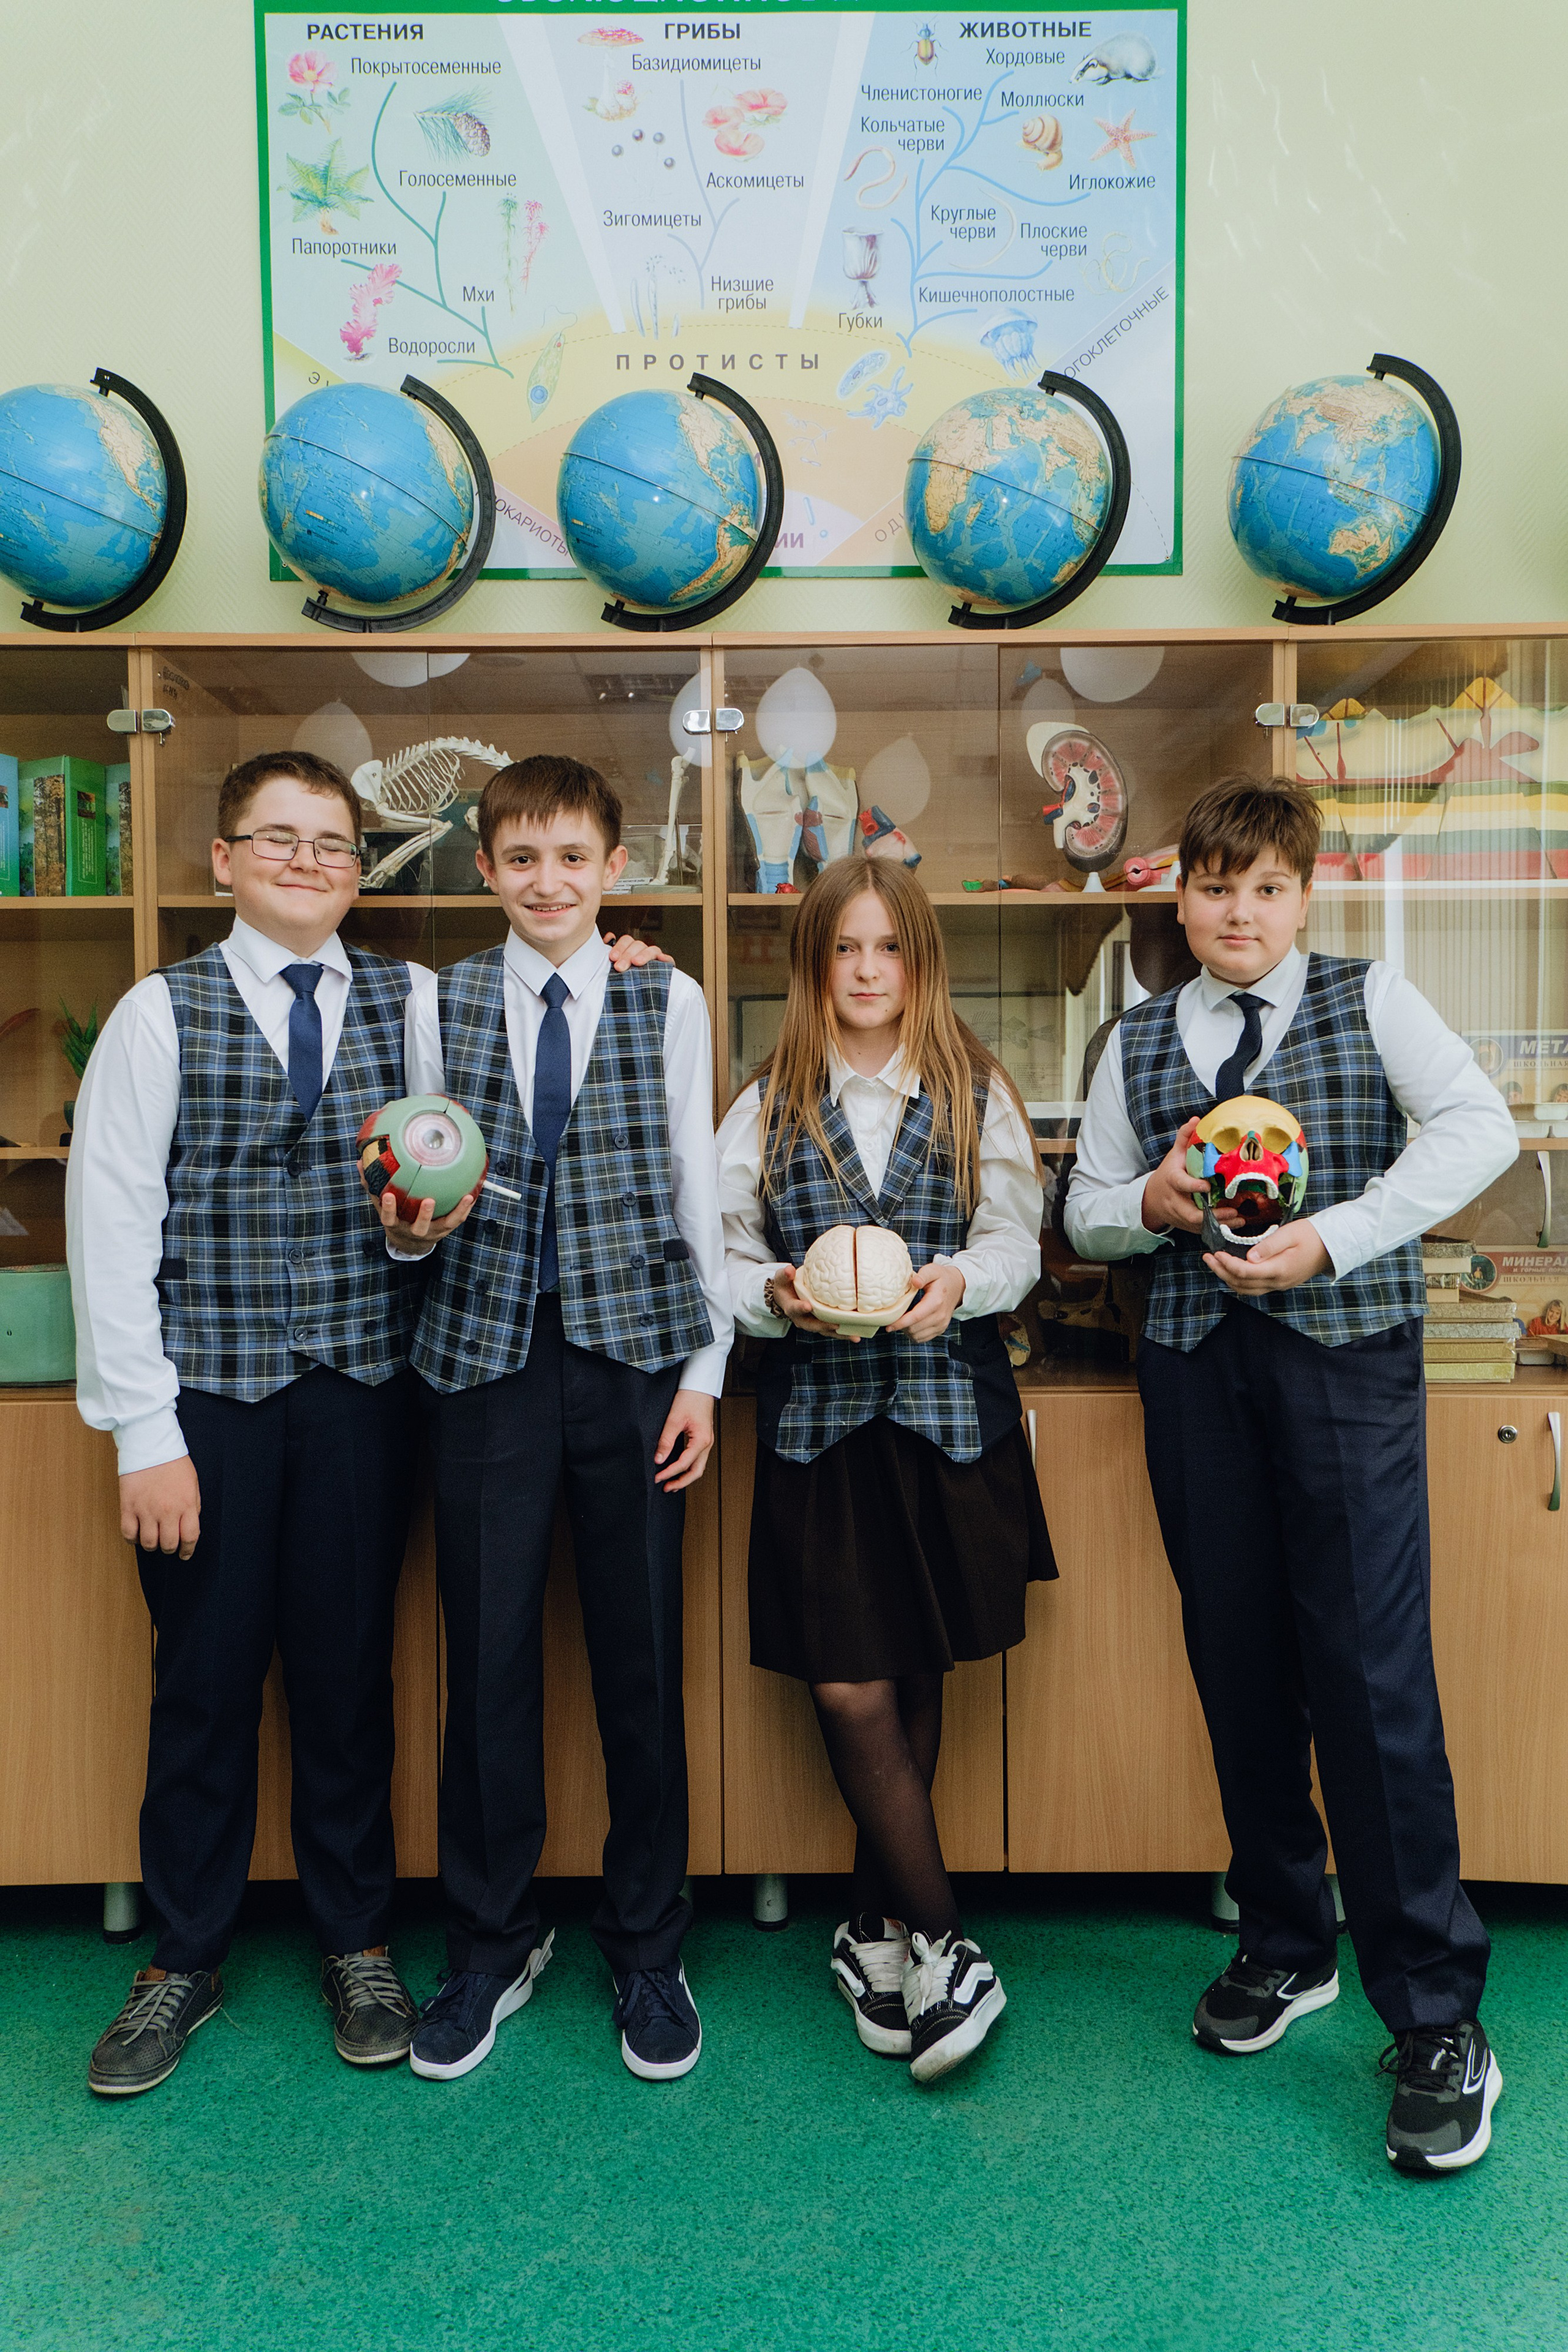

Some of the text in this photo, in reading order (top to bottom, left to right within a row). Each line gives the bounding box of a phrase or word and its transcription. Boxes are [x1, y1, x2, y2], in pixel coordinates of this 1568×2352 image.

[307, 24, 424, 40] РАСТЕНИЯ
[665, 23, 741, 39] ГРИБЫ
[959, 21, 1091, 38] ЖИВОТНЫЕ
[632, 55, 761, 73] Базидиомицеты
[986, 49, 1065, 67] Хордовые
[351, 58, 501, 78] Покрытосеменные
[861, 85, 982, 100] Членистоногие
[1001, 91, 1084, 107] Моллюски
[861, 117, 944, 132] Кольчатые
[898, 138, 944, 154] черви
[399, 171, 517, 186] Голосеменные
[706, 173, 804, 190] Аскомицеты
[1069, 175, 1156, 190] Иглокожие
[603, 210, 701, 228] Зигомицеты
[931, 205, 996, 224] Круглые
[950, 226, 995, 241] черви
[1020, 224, 1087, 238] Плоские
[292, 238, 396, 258] Папоротники
[1041, 245, 1087, 260] черви
[711, 276, 774, 292] Низшие
[463, 287, 494, 301] Мхи
[919, 287, 1074, 303] Кишечнополостные
[718, 295, 766, 313] грибы
[839, 312, 883, 332] Губки
[1064, 286, 1169, 379] ОГОКЛЕТОЧНЫЕ
[388, 338, 475, 357] Водоросли
[475, 491, 568, 556] ОКАРИОТЫ
